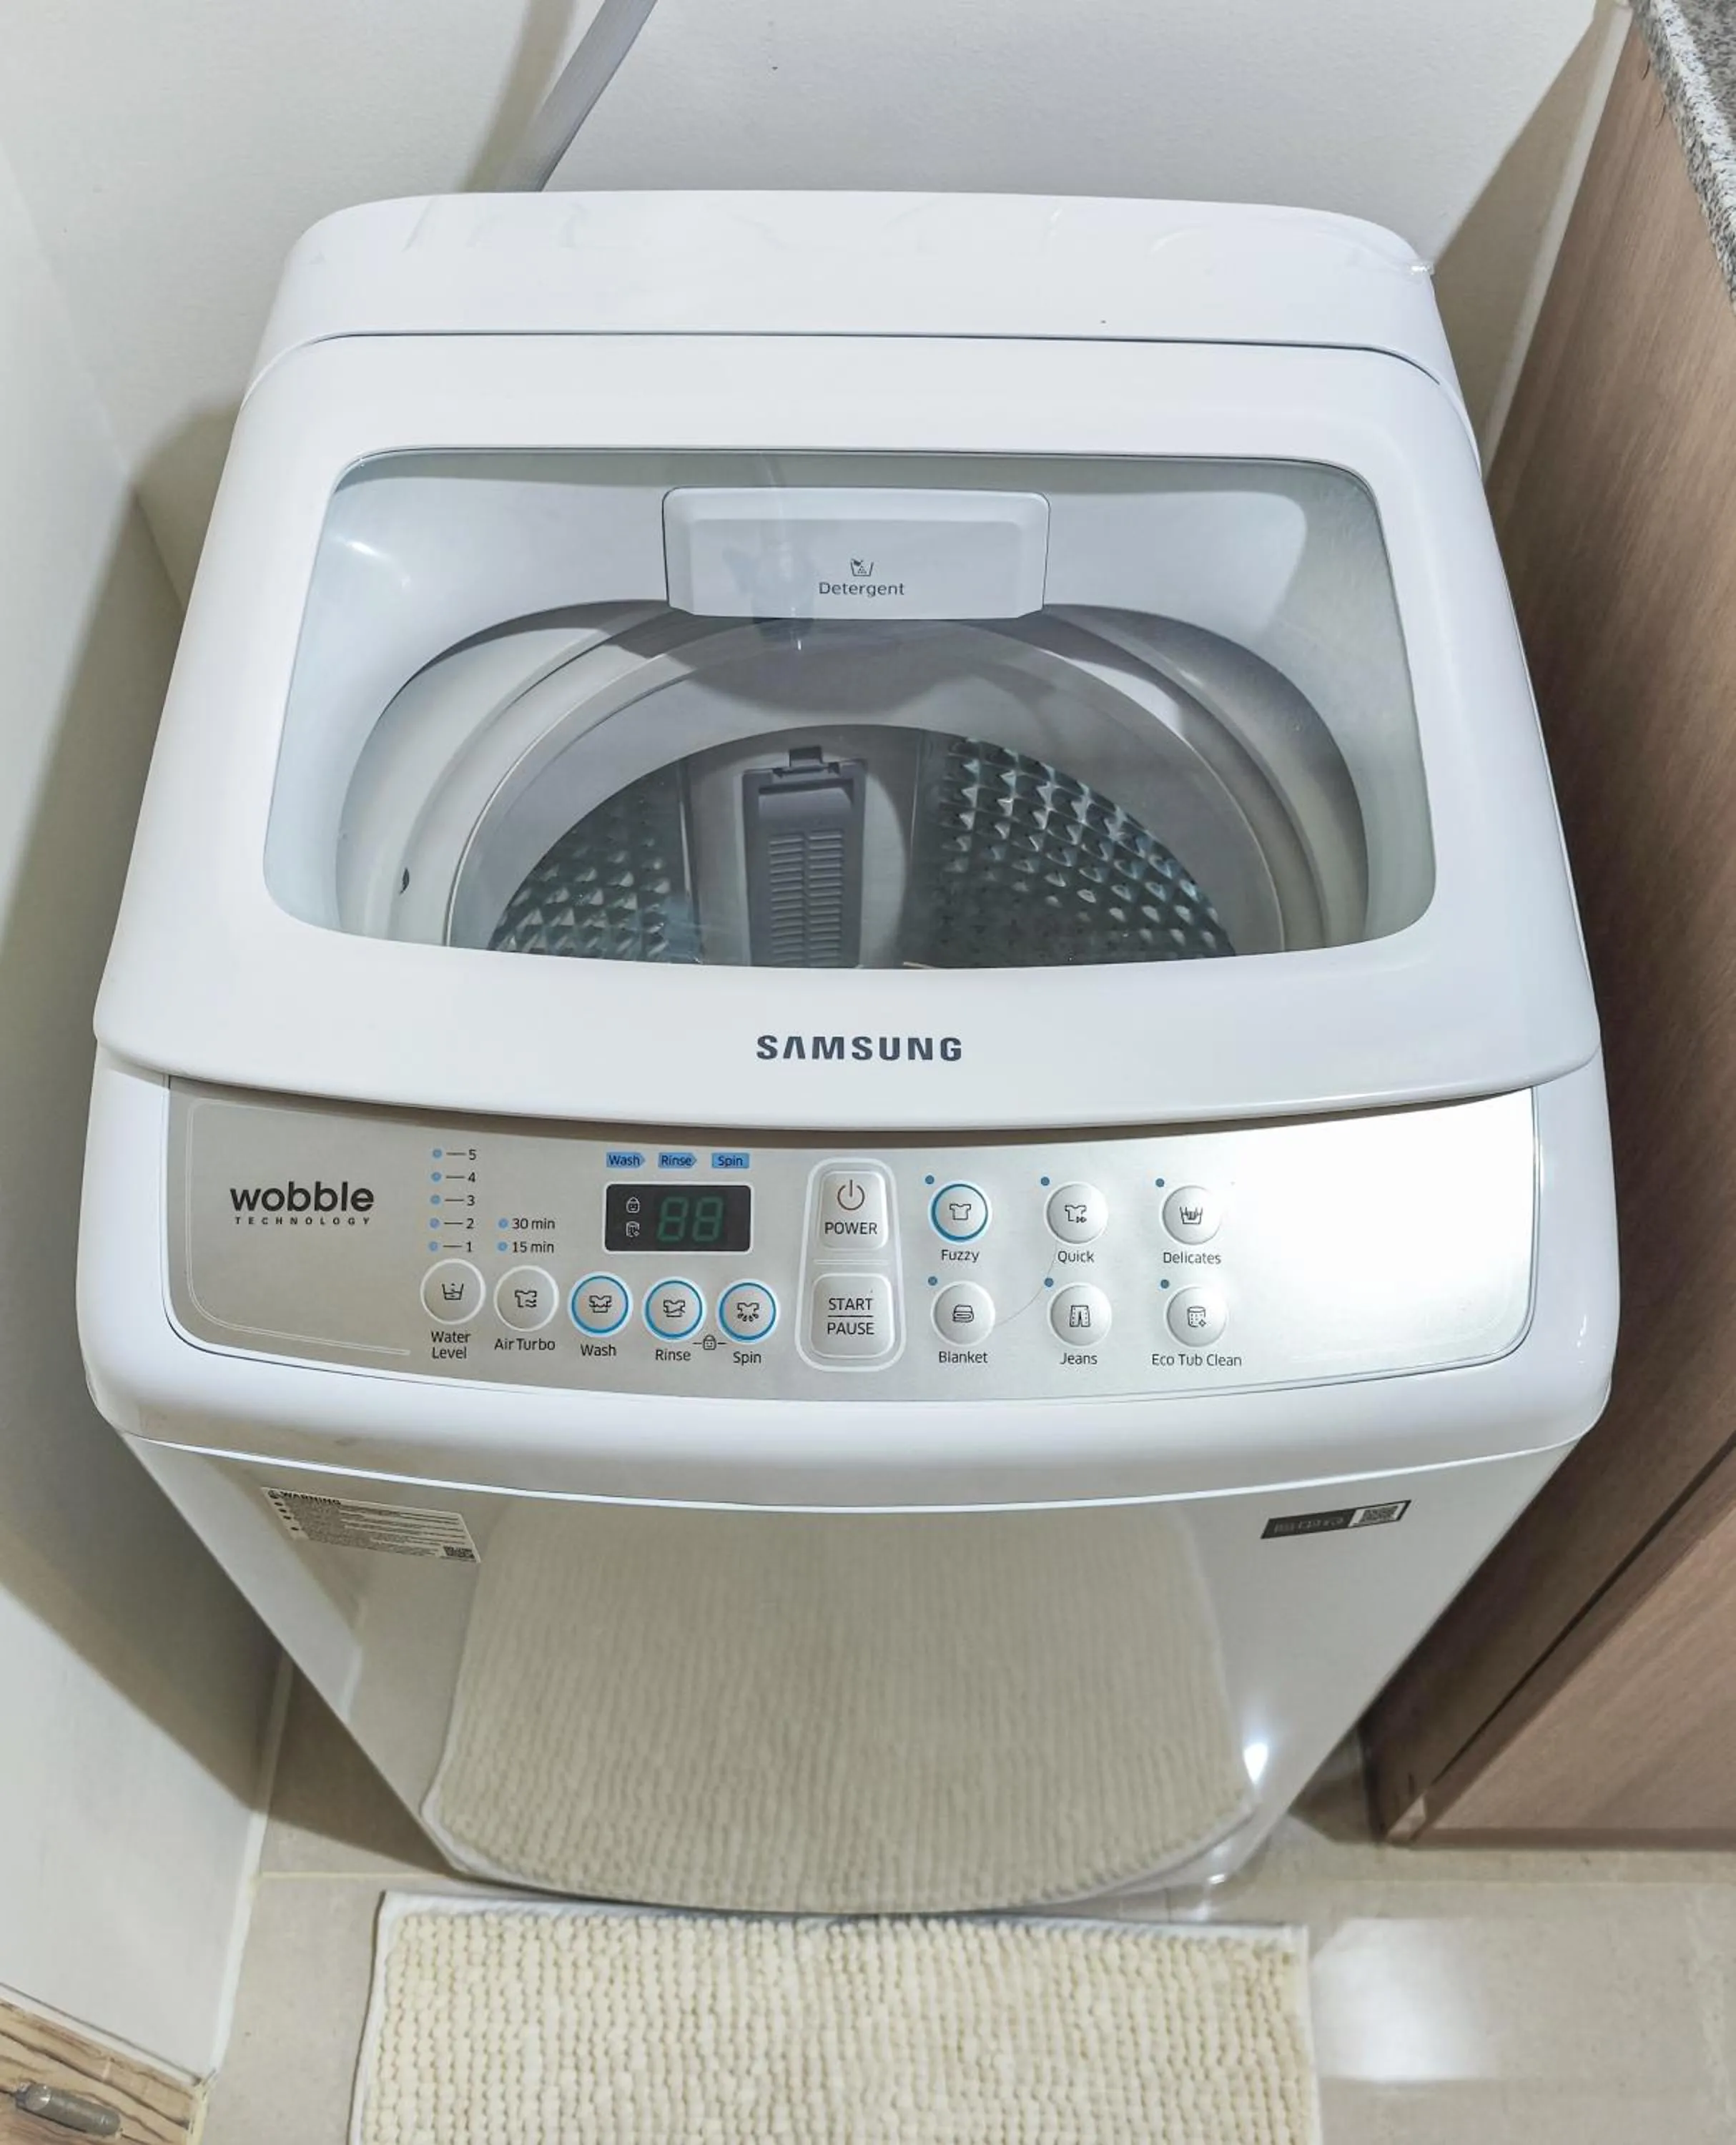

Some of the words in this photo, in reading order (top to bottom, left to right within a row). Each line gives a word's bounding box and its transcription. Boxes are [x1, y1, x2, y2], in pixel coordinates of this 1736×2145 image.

[819, 582, 904, 597] Detergent
[756, 1035, 962, 1062] SAMSUNG
[468, 1148, 477, 1160] 5
[608, 1155, 641, 1166] Wash
[661, 1155, 692, 1166] Rinse
[718, 1155, 743, 1168] Spin
[468, 1171, 476, 1183] 4
[230, 1181, 375, 1213] wobble
[467, 1195, 475, 1207] 3
[235, 1216, 370, 1226] TECHNOLOGY
[466, 1218, 475, 1230] 2
[512, 1218, 529, 1230] 30
[531, 1218, 555, 1230] min
[824, 1223, 877, 1235] POWER
[465, 1241, 472, 1253] 1
[512, 1241, 528, 1253] 15
[531, 1241, 554, 1253] min
[941, 1249, 980, 1263] Fuzzy
[1057, 1250, 1095, 1265] Quick
[1163, 1251, 1221, 1264] Delicates
[828, 1298, 873, 1311] START
[827, 1322, 874, 1335] PAUSE
[431, 1331, 470, 1344] Water
[494, 1338, 515, 1350] Air
[516, 1338, 556, 1351] Turbo
[581, 1343, 616, 1356] Wash
[431, 1346, 467, 1359] Level
[656, 1348, 691, 1361] Rinse
[733, 1351, 761, 1366] Spin
[939, 1351, 988, 1364] Blanket
[1060, 1353, 1098, 1366] Jeans
[1152, 1354, 1175, 1366] Eco
[1178, 1354, 1203, 1366] Tub
[1207, 1354, 1242, 1366] Clean
